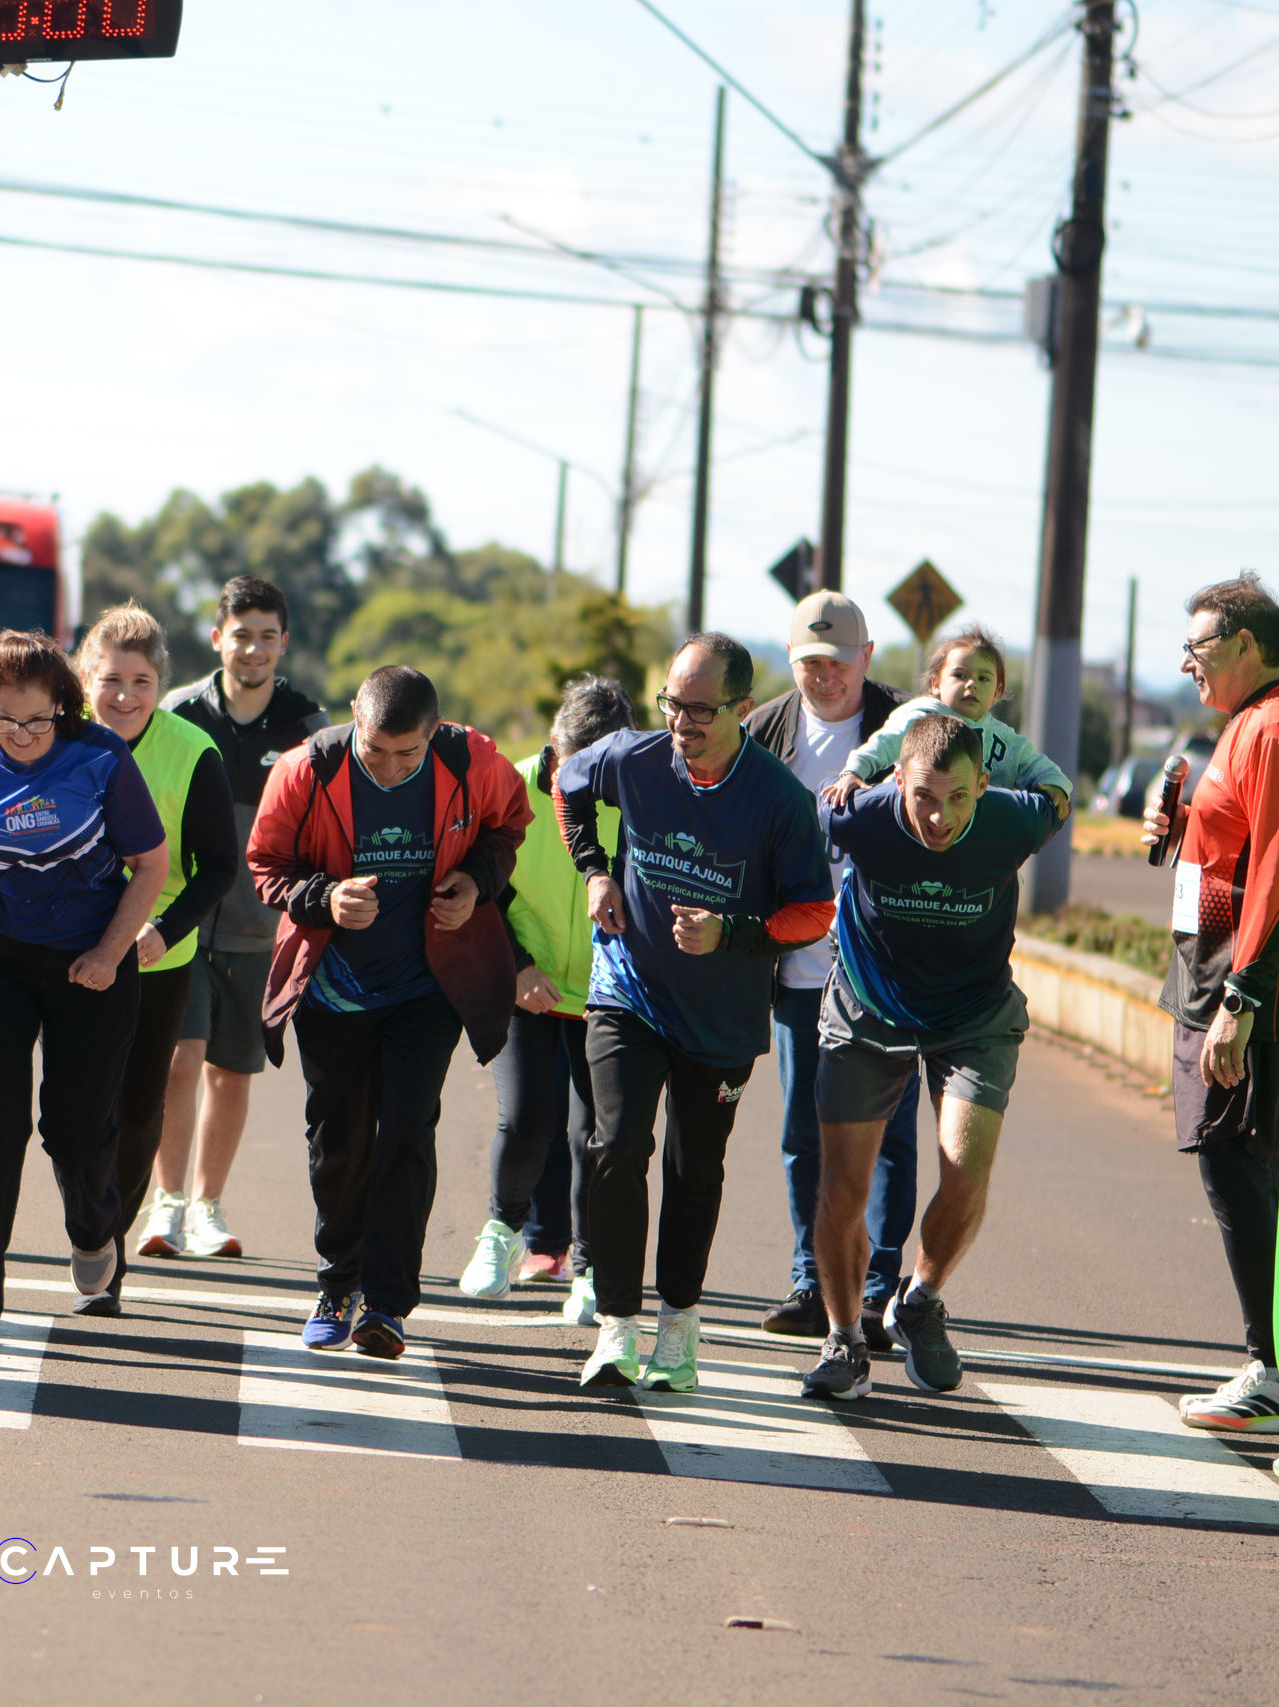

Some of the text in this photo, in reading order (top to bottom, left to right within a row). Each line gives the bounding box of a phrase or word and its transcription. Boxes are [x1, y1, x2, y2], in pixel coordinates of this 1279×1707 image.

[6, 813, 36, 831] ONG
[353, 850, 435, 863] RATIQUE AJUD
[633, 847, 733, 889] PRATIQUE AJUDA
[667, 884, 692, 898] FÍSICA
[692, 892, 704, 900] EM
[704, 895, 727, 904] AÇÃO
[880, 896, 983, 913] PRATIQUE AJUDA
